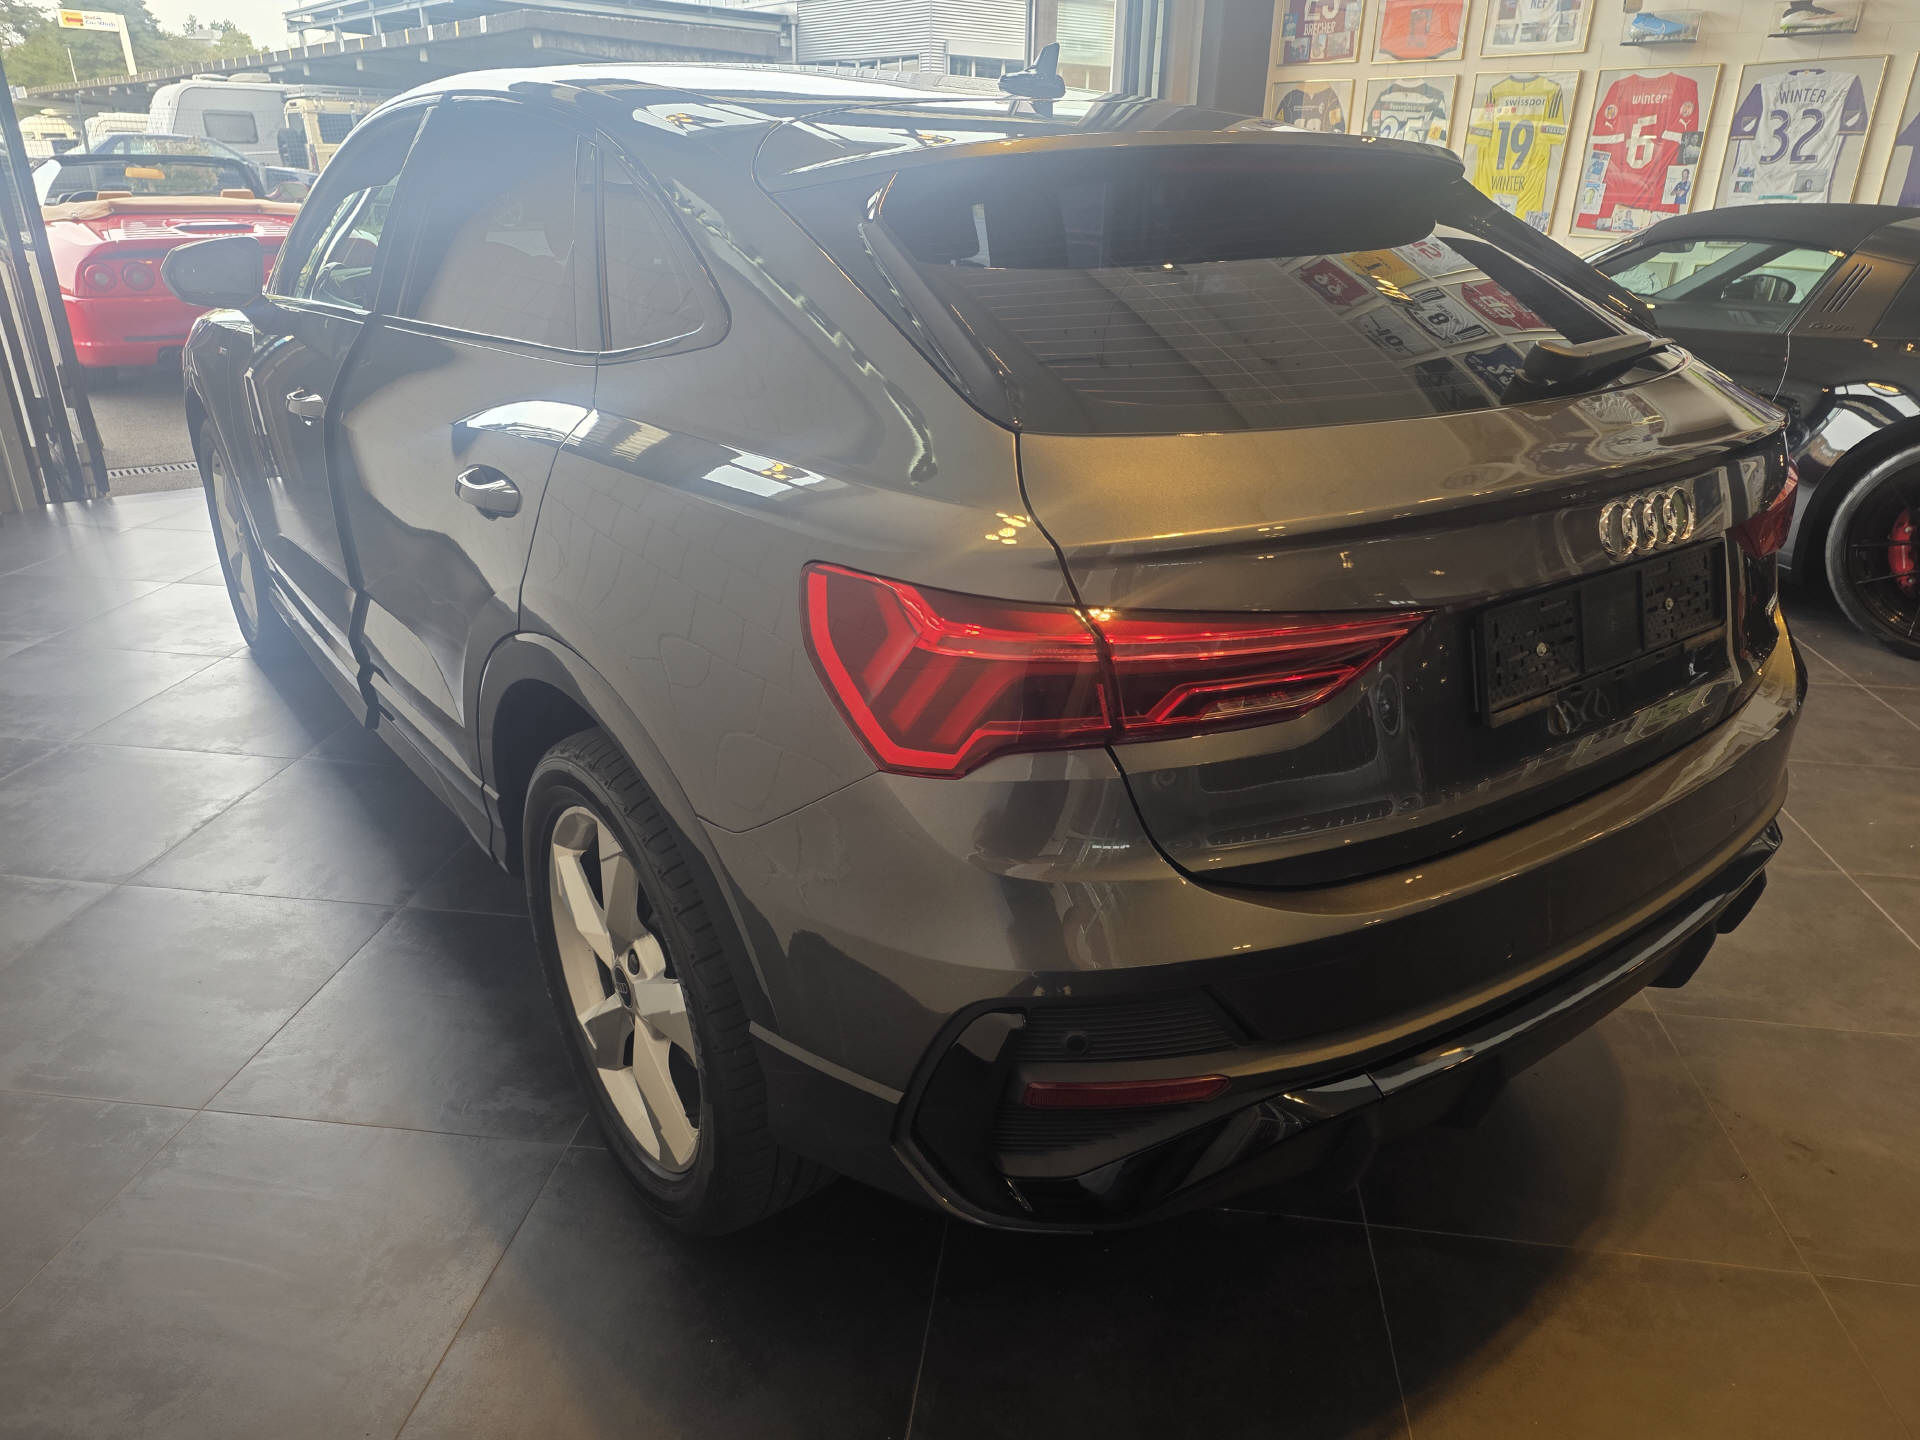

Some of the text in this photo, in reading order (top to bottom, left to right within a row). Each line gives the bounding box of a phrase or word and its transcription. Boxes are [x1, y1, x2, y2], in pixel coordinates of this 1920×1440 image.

[1631, 92, 1668, 105] winter
[1779, 88, 1827, 105] WINTER
[1496, 120, 1535, 171] 19
[1626, 114, 1658, 169] 6
[1758, 108, 1825, 165] 32
[1491, 175, 1526, 192] WINTER
